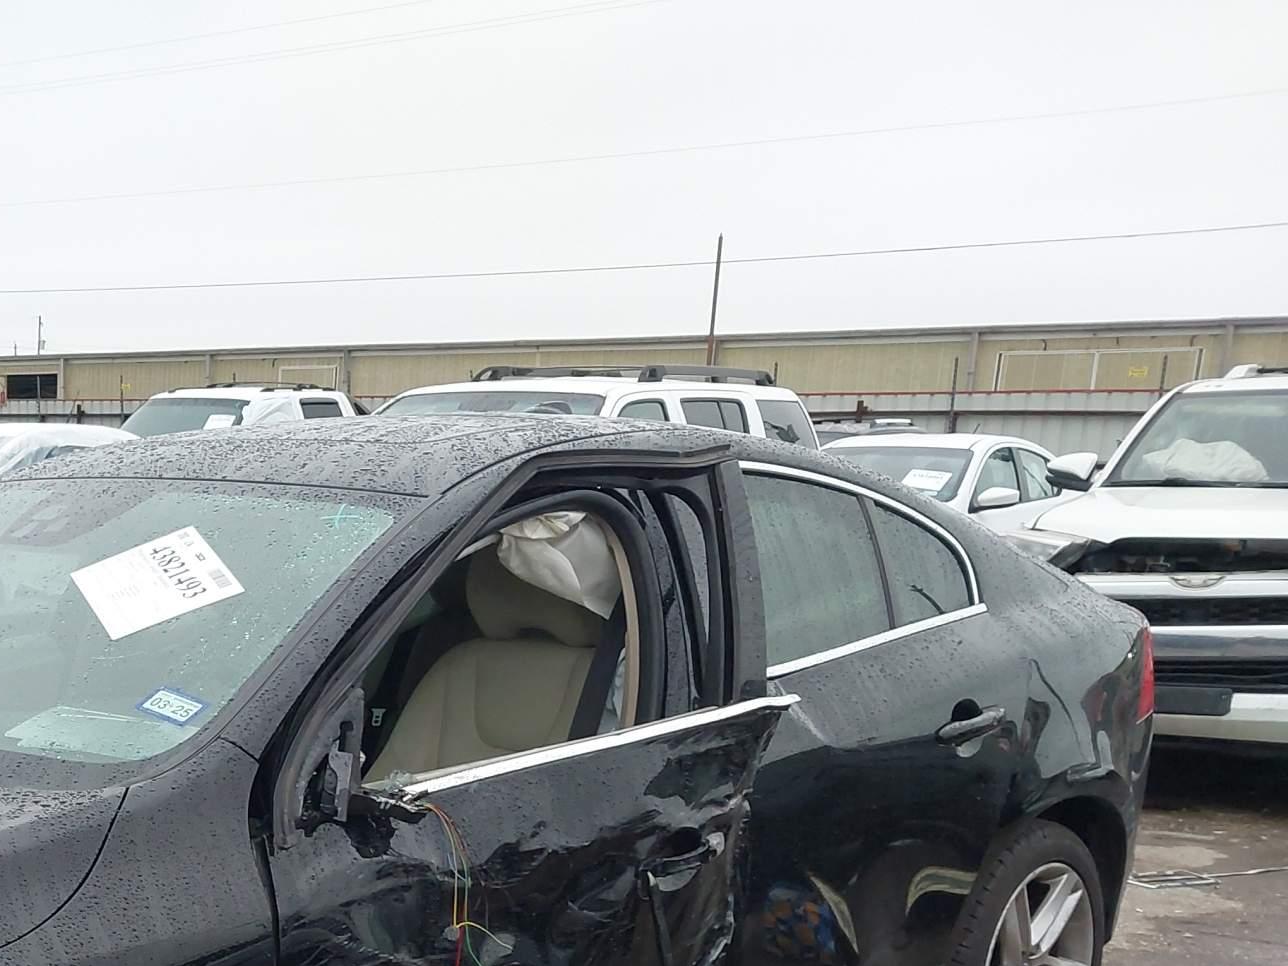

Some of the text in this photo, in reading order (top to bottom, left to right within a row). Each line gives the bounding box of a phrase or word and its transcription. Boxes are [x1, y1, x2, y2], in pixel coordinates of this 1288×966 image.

[149, 546, 207, 599] 43821493
[149, 697, 193, 718] 03 25
